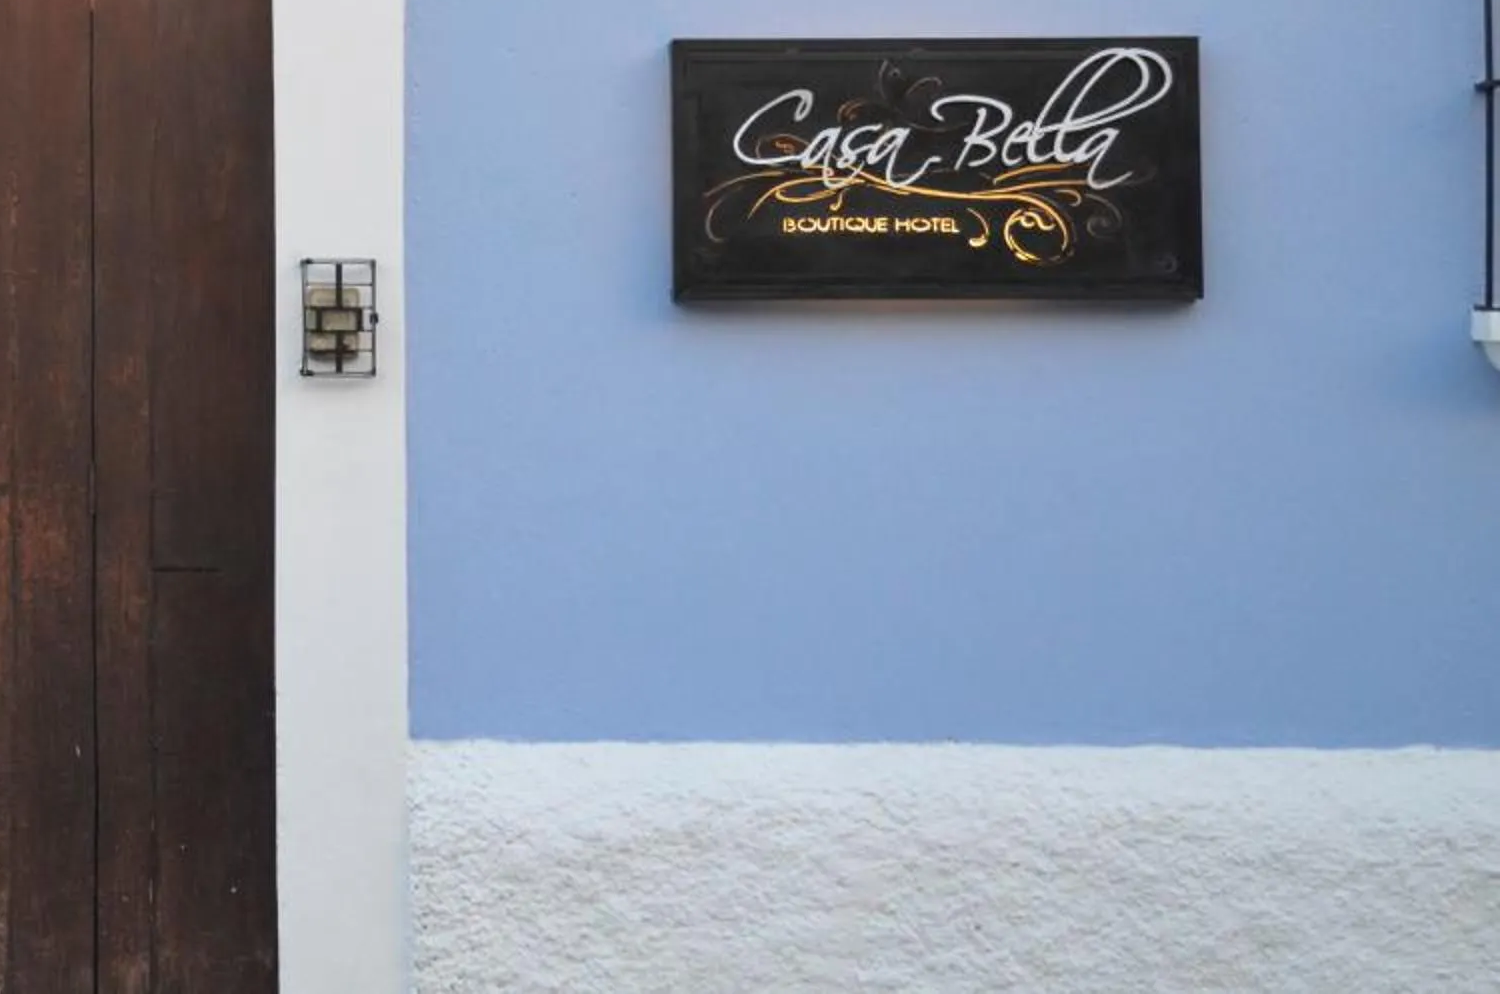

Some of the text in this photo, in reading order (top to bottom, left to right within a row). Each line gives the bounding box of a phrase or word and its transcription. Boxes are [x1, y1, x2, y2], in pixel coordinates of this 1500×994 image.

[733, 47, 1173, 190] Casa Bella
[783, 217, 960, 234] BOUTIQUE HOTEL
